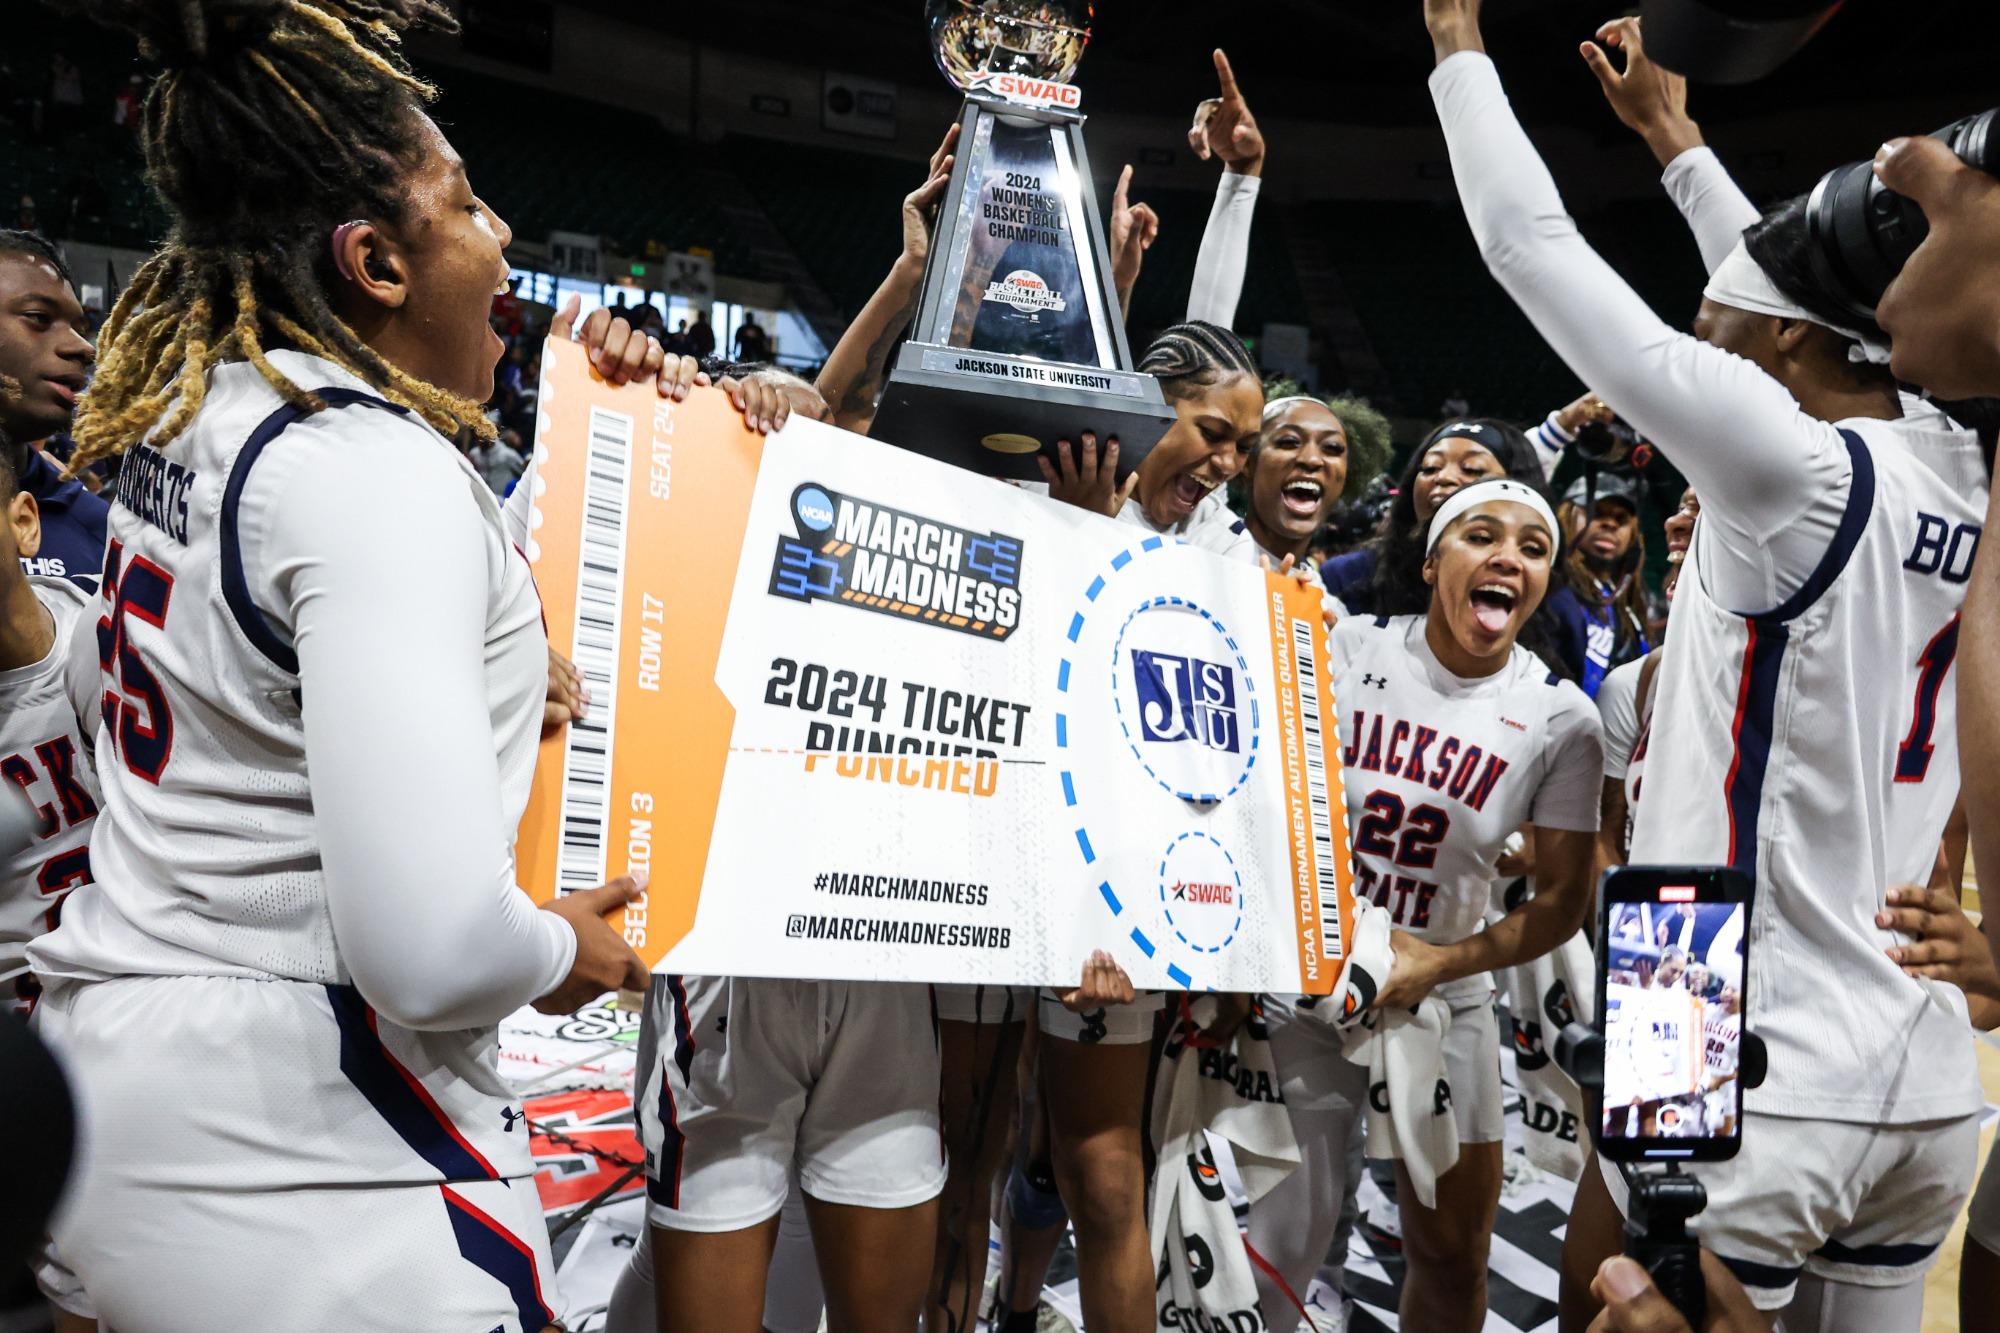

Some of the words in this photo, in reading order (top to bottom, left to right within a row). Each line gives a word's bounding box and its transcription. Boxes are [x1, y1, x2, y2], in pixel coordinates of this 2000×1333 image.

[999, 75, 1078, 106] SWAC
[1005, 172, 1041, 191] 2024
[983, 203, 1064, 230] BASKETBALL
[992, 187, 1056, 212] WOMEN'S
[988, 222, 1059, 248] CHAMPION
[989, 281, 1064, 302] BASKETBALL
[993, 292, 1057, 309] TOURNAMENT
[1015, 278, 1043, 290] SWAC
[955, 358, 1009, 377] JACKSON
[1011, 365, 1046, 381] STATE
[1049, 370, 1111, 390] UNIVERSITY
[653, 400, 675, 435] 24
[649, 434, 673, 500] SEAT
[801, 503, 833, 525] NCAA
[834, 499, 963, 572] MARCH
[850, 548, 1021, 628] MADNESS
[642, 591, 664, 624] 17
[1272, 591, 1293, 685] QUALIFIER
[638, 626, 662, 692] ROW
[763, 656, 888, 724] 2024
[901, 681, 1032, 748] TICKET
[1281, 687, 1302, 793] AUTOMATIC
[803, 720, 1000, 798] PUNCHED
[1343, 710, 1510, 813] JACKSON
[630, 791, 654, 814] 3
[1352, 788, 1451, 869] 22
[1291, 795, 1313, 924] TOURNAMENT
[623, 818, 653, 949] SECION
[813, 871, 989, 906] #MARCHMADNESS
[1188, 882, 1232, 905] SWAC
[1353, 857, 1438, 929] TATE
[785, 914, 1012, 949] @MARCHMADNESSWBB
[1303, 928, 1319, 981] NCAA
